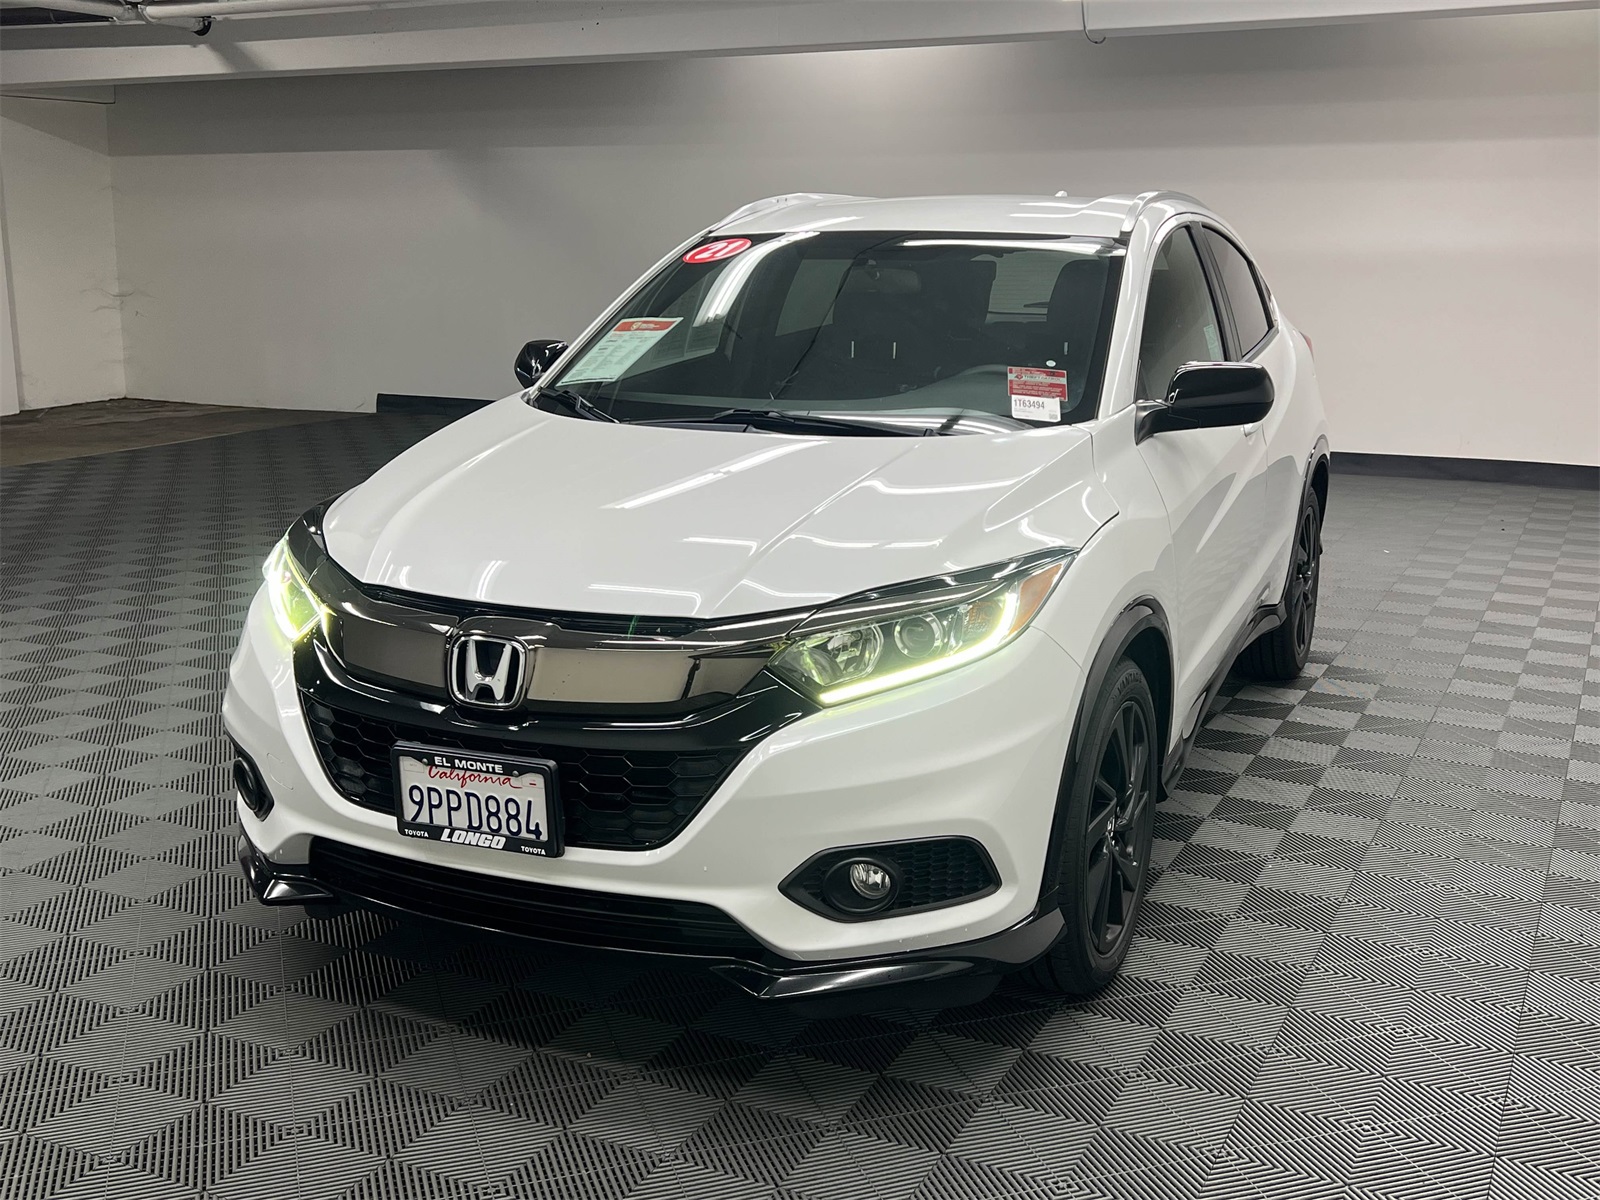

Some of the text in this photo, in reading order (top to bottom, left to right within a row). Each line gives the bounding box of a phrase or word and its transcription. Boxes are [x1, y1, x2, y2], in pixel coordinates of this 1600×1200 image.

[1013, 399, 1045, 409] 1T63494
[434, 756, 504, 774] EL MONTE
[428, 765, 522, 789] California
[408, 784, 543, 840] 9PPD884
[404, 828, 429, 838] TOYOTA
[440, 828, 506, 850] LONGO
[520, 845, 546, 855] TOYOTA
